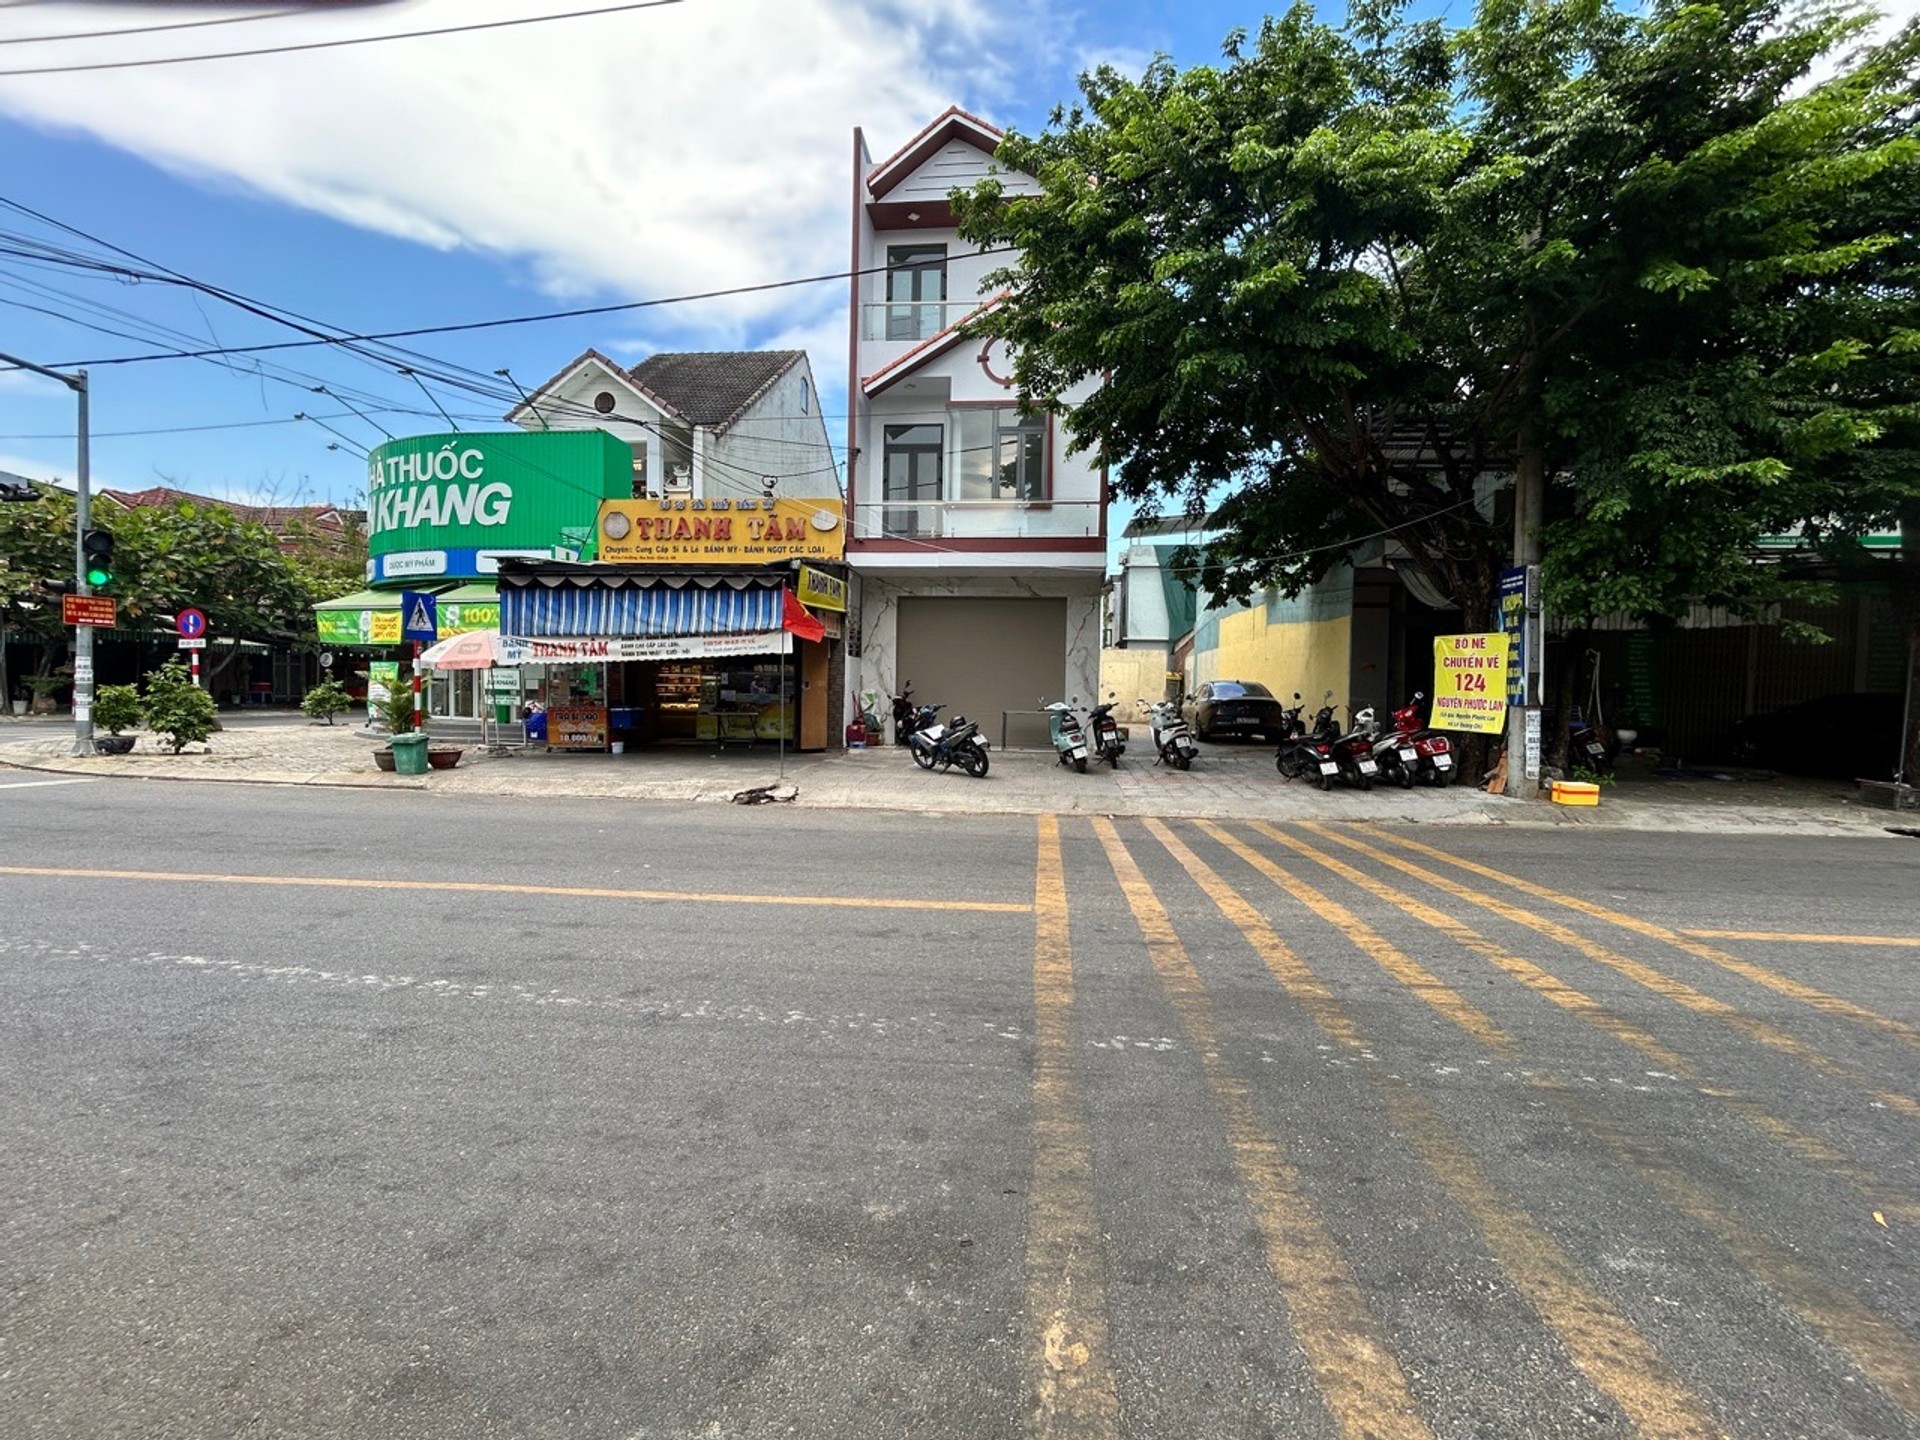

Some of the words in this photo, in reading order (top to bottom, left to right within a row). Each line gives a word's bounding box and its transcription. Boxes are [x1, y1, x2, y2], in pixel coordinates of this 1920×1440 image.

[387, 440, 484, 484] THUỐC
[377, 482, 512, 532] KHANG
[636, 516, 732, 540] THANH
[788, 545, 804, 554] CÁC
[578, 637, 609, 657] TÂM
[1455, 674, 1486, 692] 124
[1488, 700, 1504, 712] LAN
